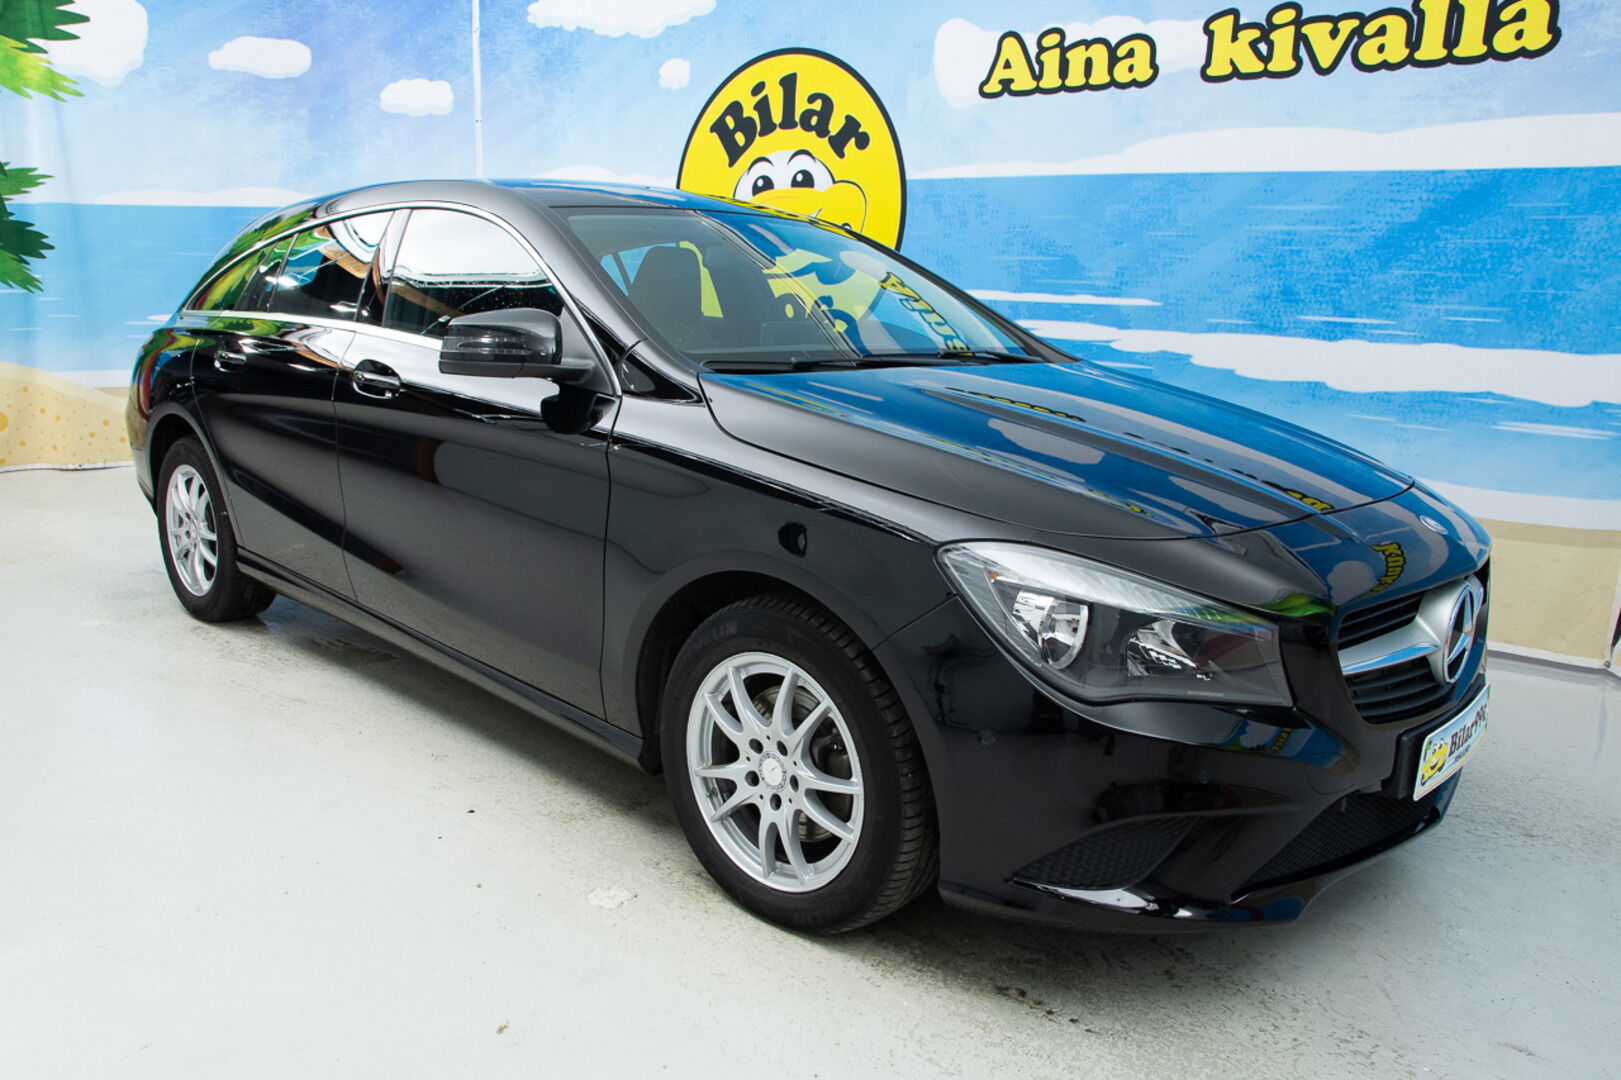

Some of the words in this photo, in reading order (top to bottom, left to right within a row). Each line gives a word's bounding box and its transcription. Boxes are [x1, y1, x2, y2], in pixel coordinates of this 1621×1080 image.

[979, 28, 1159, 98] Aina
[1200, 0, 1561, 82] kivalla
[709, 72, 870, 168] Bilar
